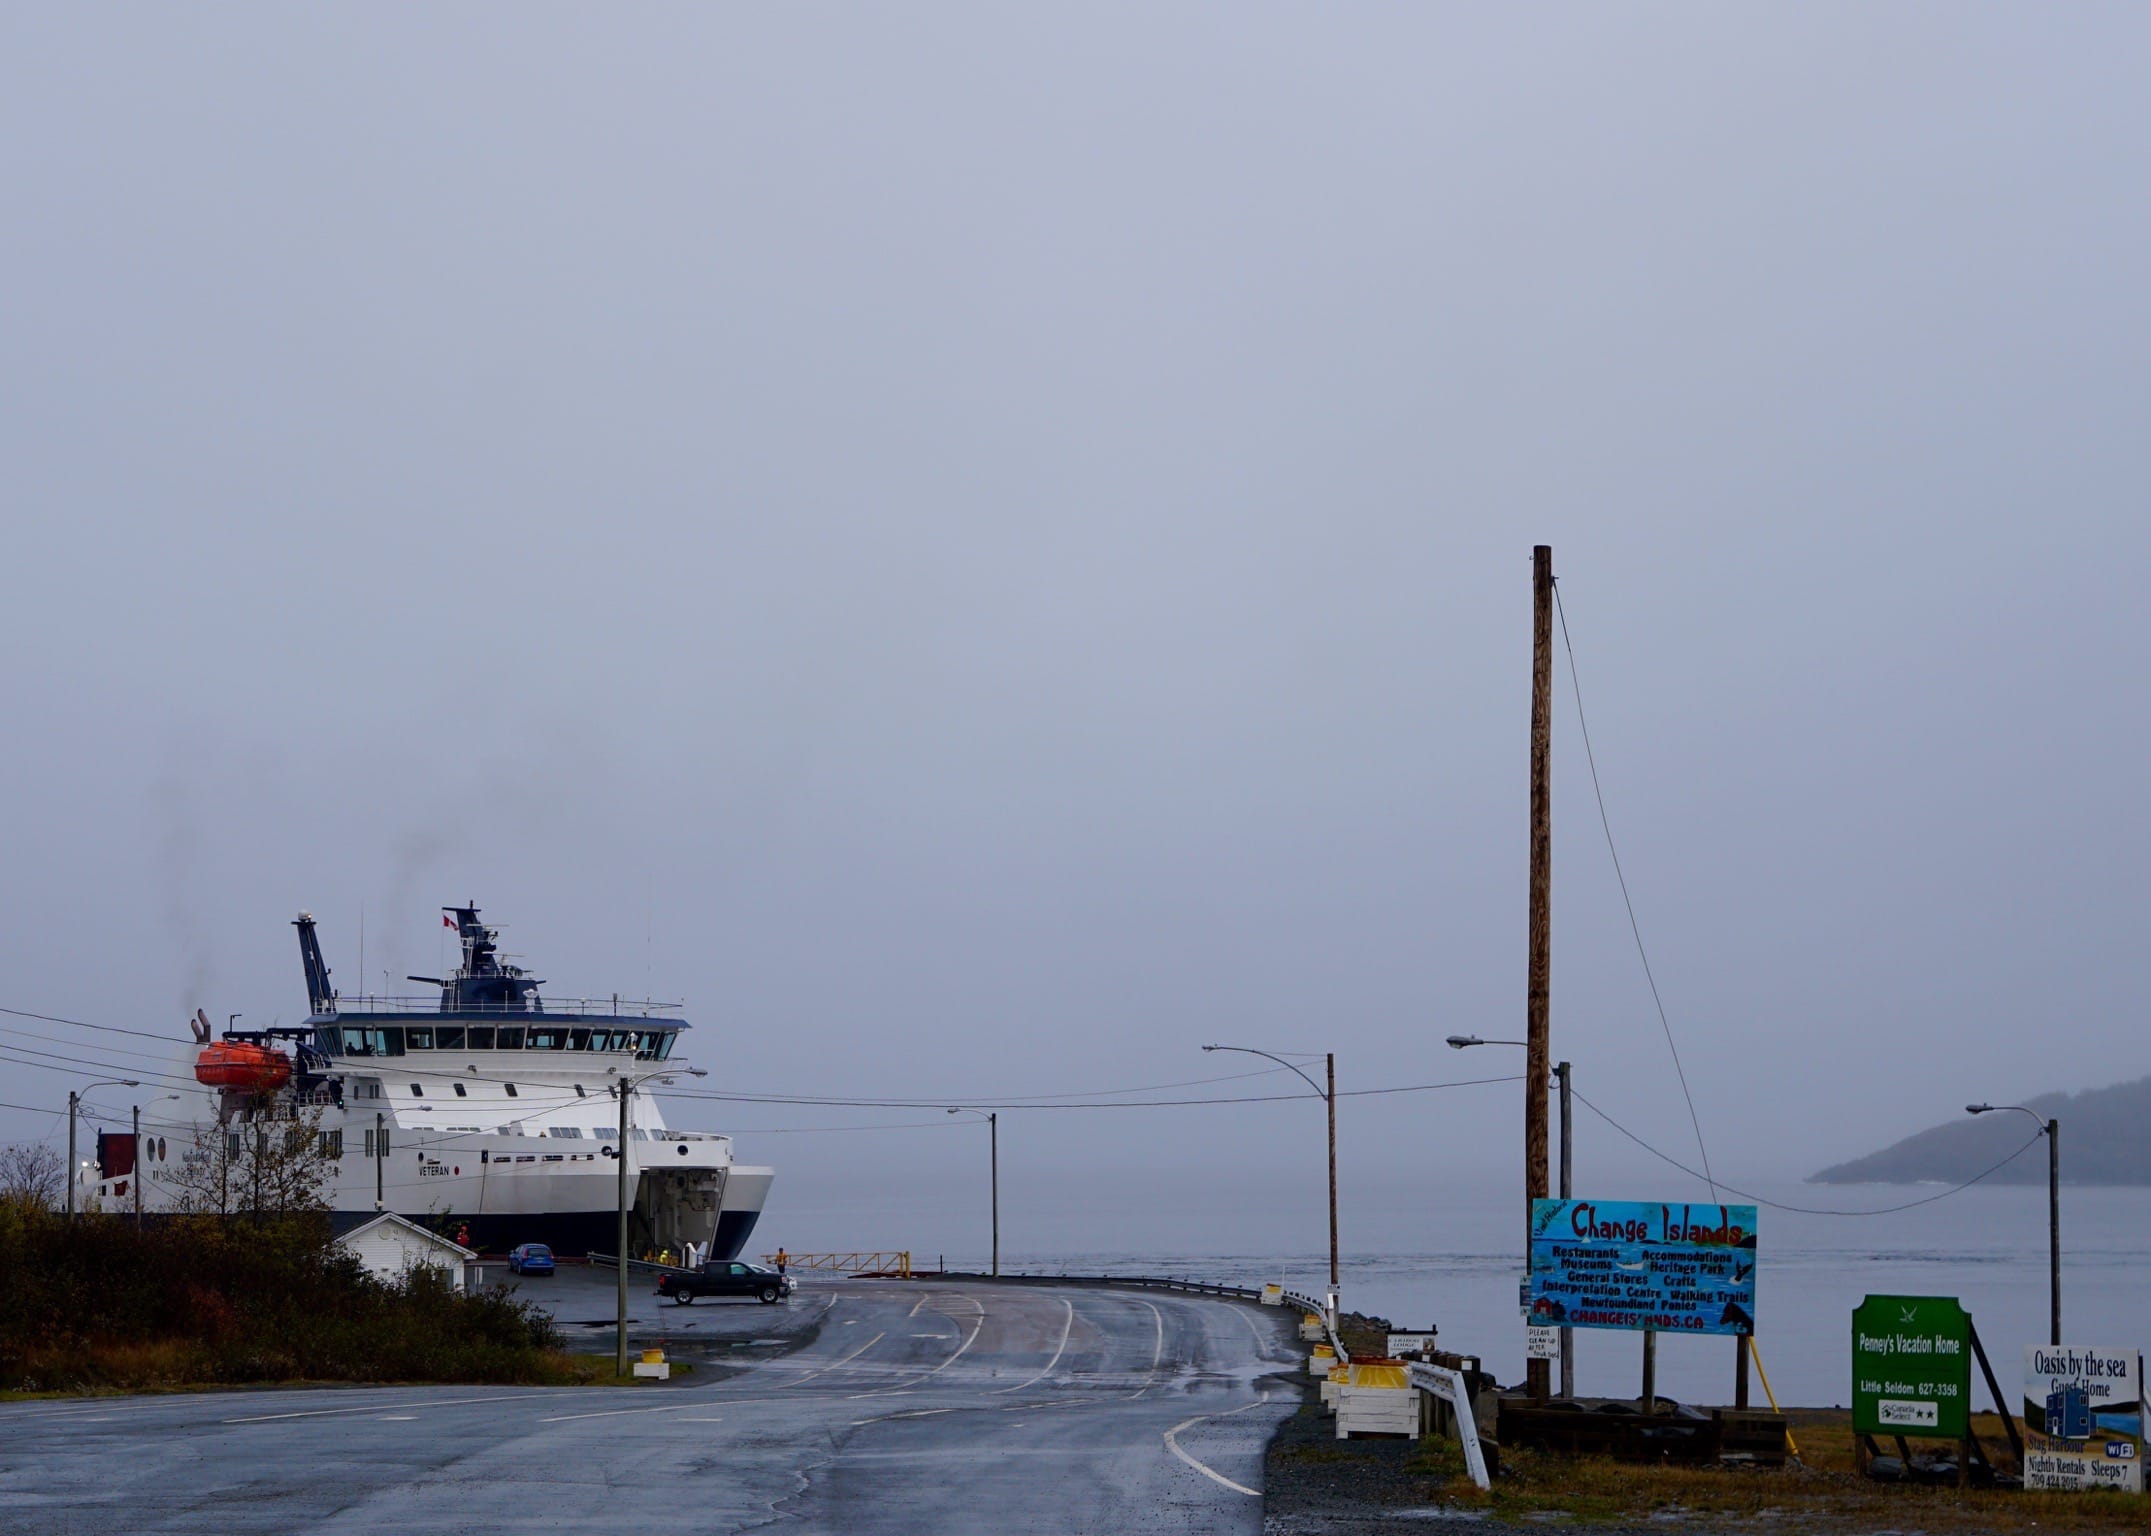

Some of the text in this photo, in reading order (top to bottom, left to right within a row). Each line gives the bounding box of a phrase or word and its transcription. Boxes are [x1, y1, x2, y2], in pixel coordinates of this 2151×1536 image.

[419, 1166, 449, 1176] VETERAN
[1572, 1202, 1743, 1245] Change Islands
[1552, 1246, 1732, 1263] Restaurants Accommodations
[1560, 1258, 1725, 1275] Museums Heritage Park
[1568, 1271, 1697, 1287] General Stores Crafts
[1542, 1280, 1749, 1303] Interpretation Centre Walking Trails
[1581, 1297, 1697, 1311] Newfoundland Ponies
[1570, 1309, 1704, 1328] CHANGEISANDS.CA
[1860, 1332, 1960, 1356] Penney's Vacation Home
[2035, 1349, 2126, 1381] Oasis by the sea
[1861, 1380, 1957, 1396] Little Seldom 627-3358
[2051, 1378, 2111, 1397] Guest Home
[2029, 1434, 2085, 1454] Stag Harbour
[2028, 1456, 2128, 1481] Nightly Rentals Sleeps 7
[2031, 1474, 2045, 1487] 709
